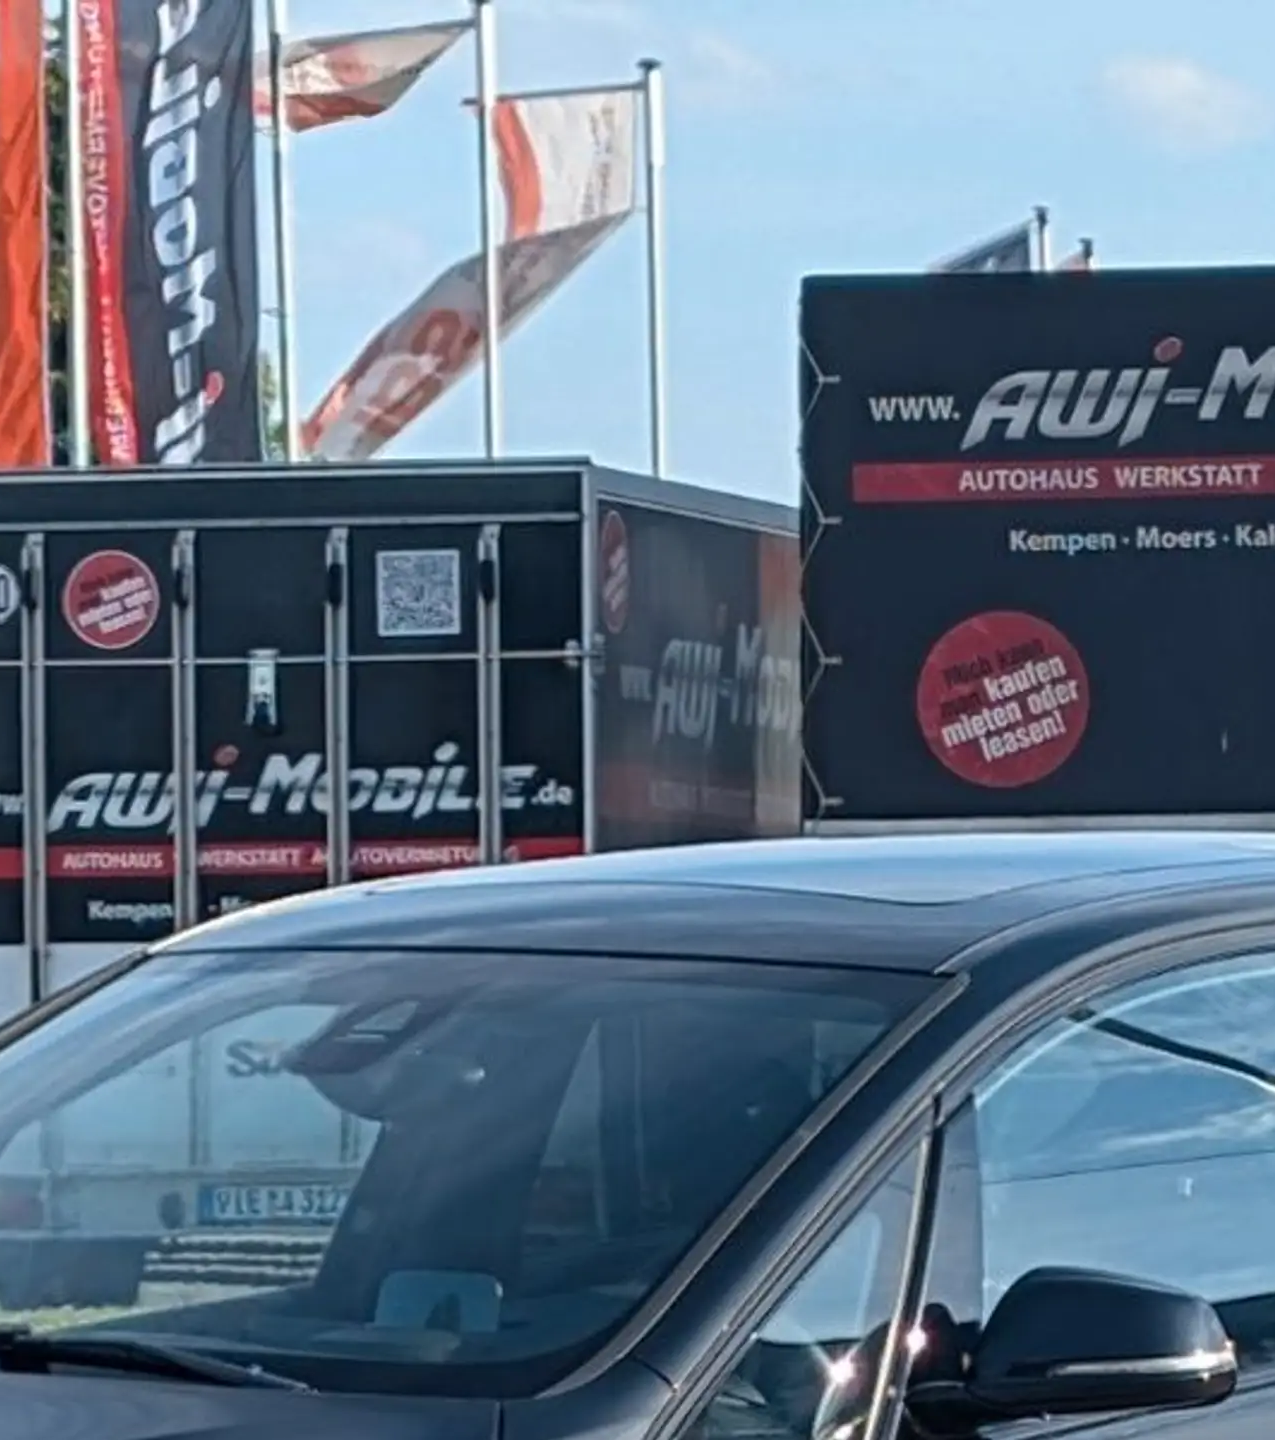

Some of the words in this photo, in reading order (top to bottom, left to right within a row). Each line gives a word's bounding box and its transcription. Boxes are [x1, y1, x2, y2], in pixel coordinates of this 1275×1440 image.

[958, 464, 1099, 494] AUTOHAUS
[1115, 461, 1264, 490] WERKSTATT
[1009, 526, 1117, 555] Kempen
[1136, 524, 1216, 551] Moers
[983, 655, 1067, 701] kaufen
[941, 700, 1023, 749] mieten
[1027, 679, 1079, 715] oder
[979, 709, 1067, 763] leasen!
[62, 852, 164, 870] AUTOHAUS
[87, 900, 174, 923] Kempen
